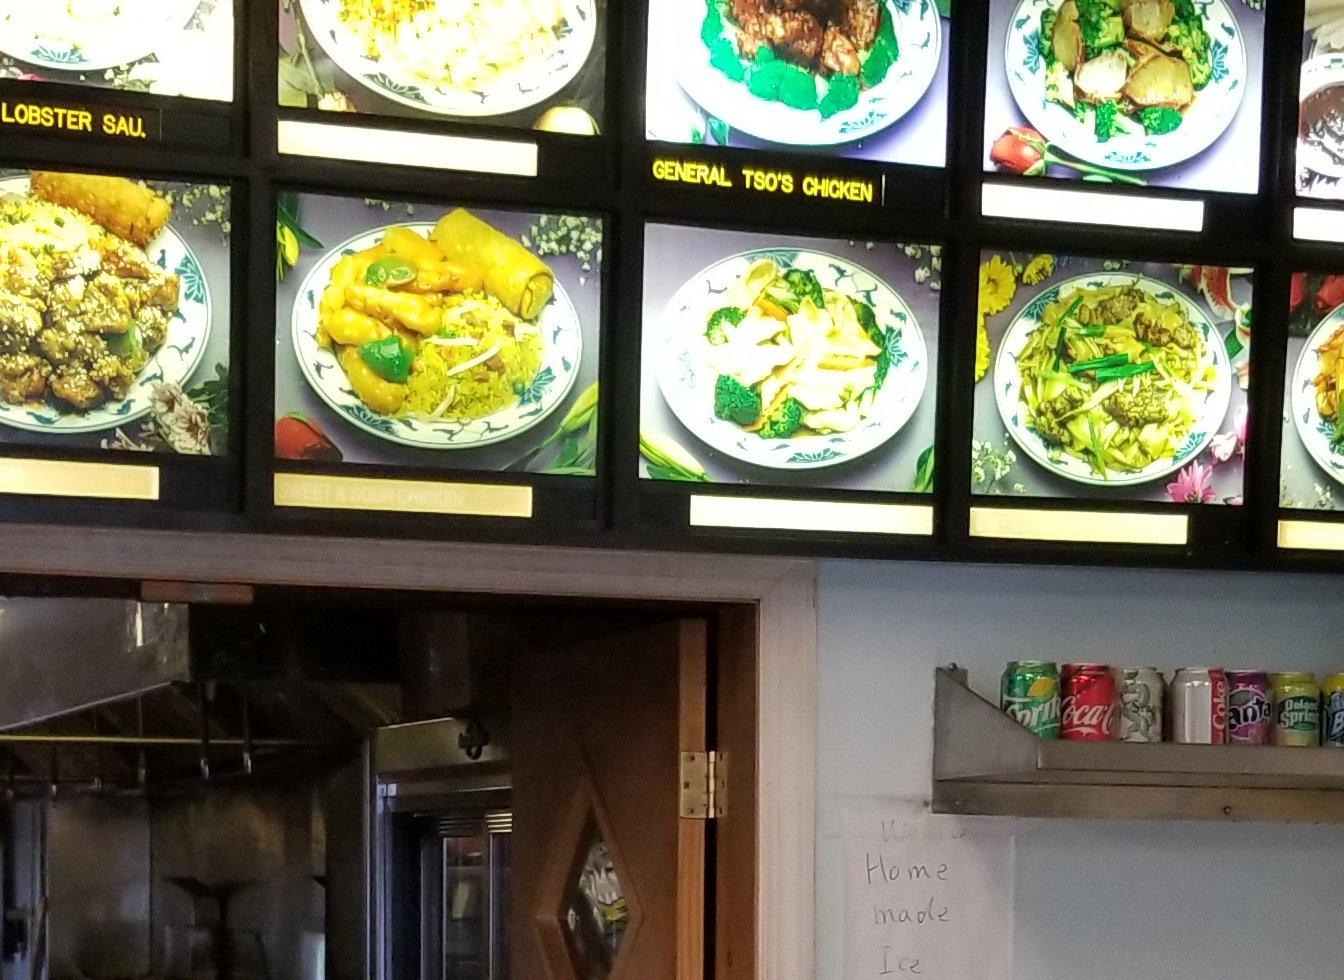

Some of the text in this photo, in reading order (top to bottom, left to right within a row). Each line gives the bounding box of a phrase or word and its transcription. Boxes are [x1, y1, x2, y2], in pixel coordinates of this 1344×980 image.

[1, 102, 92, 132] LOBSTER
[102, 114, 146, 138] SAU.
[652, 160, 873, 202] GENERAL TSO'S CHICKEN
[1228, 695, 1272, 731] anta
[865, 852, 948, 885] Home
[873, 896, 950, 925] made
[878, 945, 922, 976] Ice
